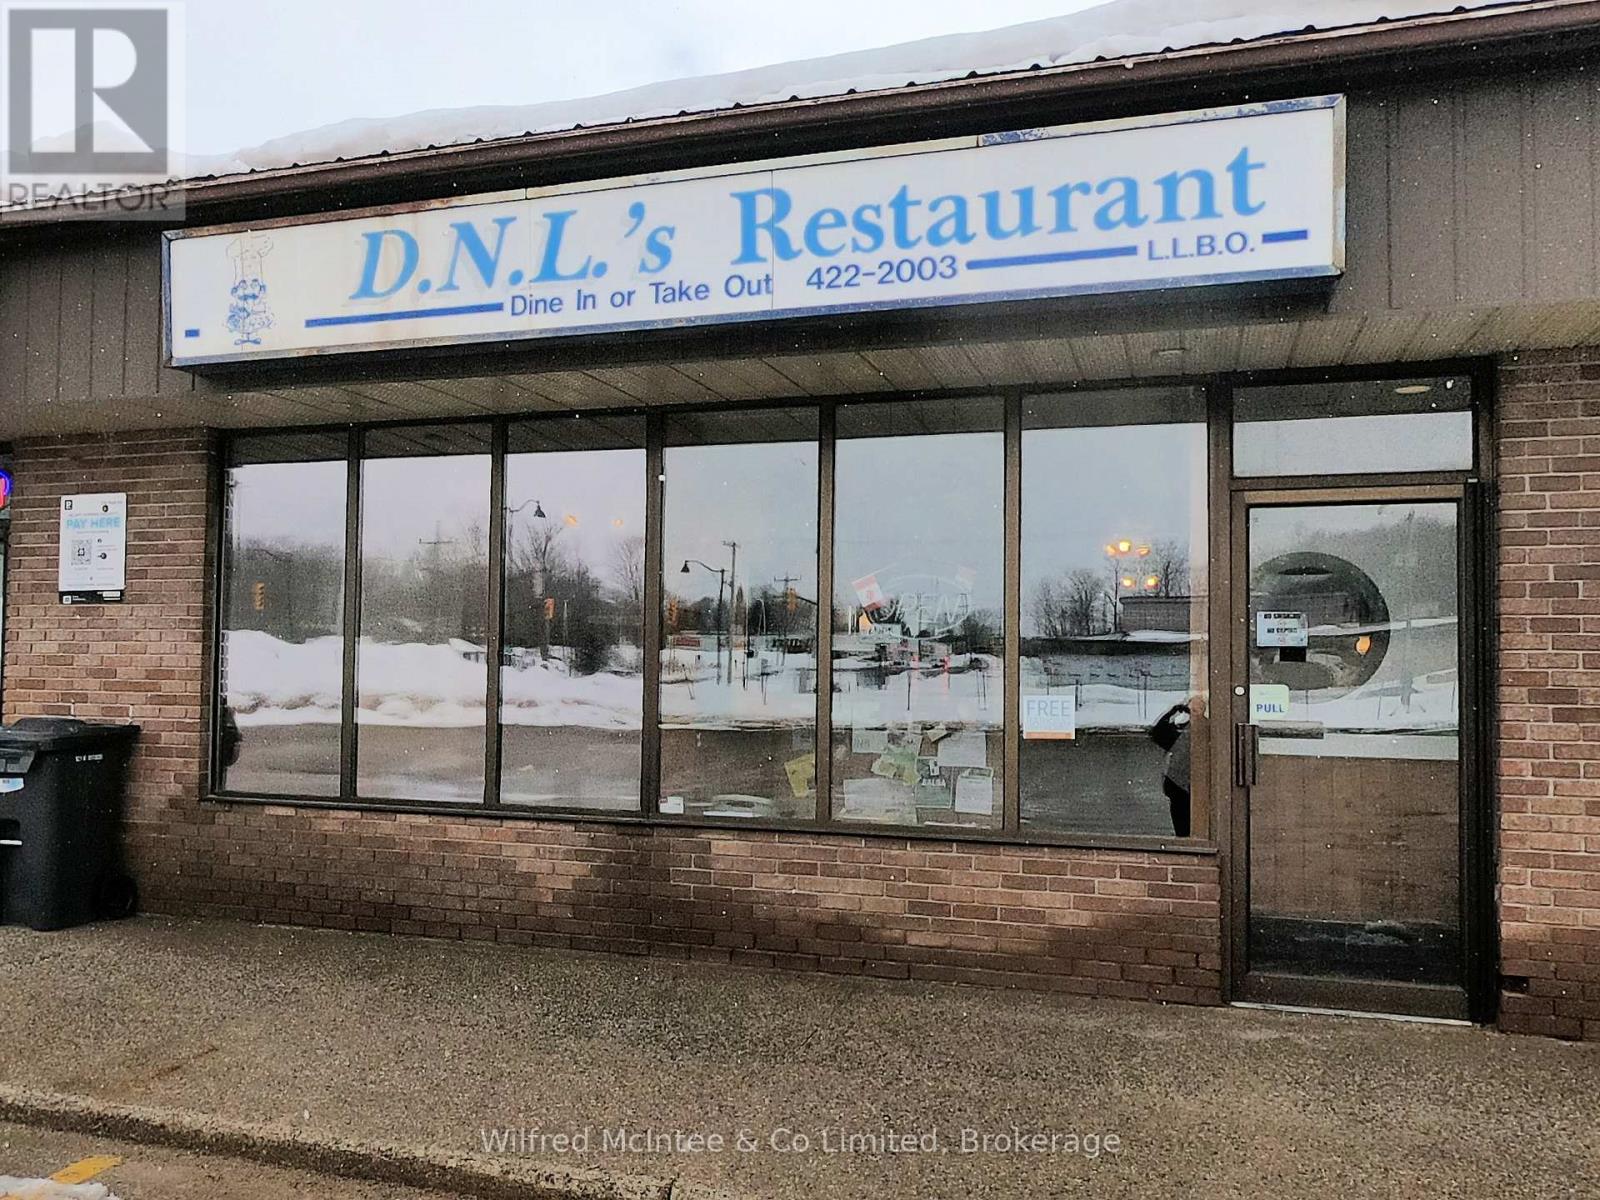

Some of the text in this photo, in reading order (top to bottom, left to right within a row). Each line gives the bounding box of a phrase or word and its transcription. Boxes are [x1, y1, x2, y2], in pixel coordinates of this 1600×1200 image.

[729, 146, 1267, 267] Restaurant
[1146, 232, 1256, 262] L.L.B.O.
[510, 254, 958, 317] Dine In or Take Out 422-2003
[91, 516, 121, 528] HERE
[1026, 699, 1072, 717] FREE
[1256, 703, 1285, 714] PULL
